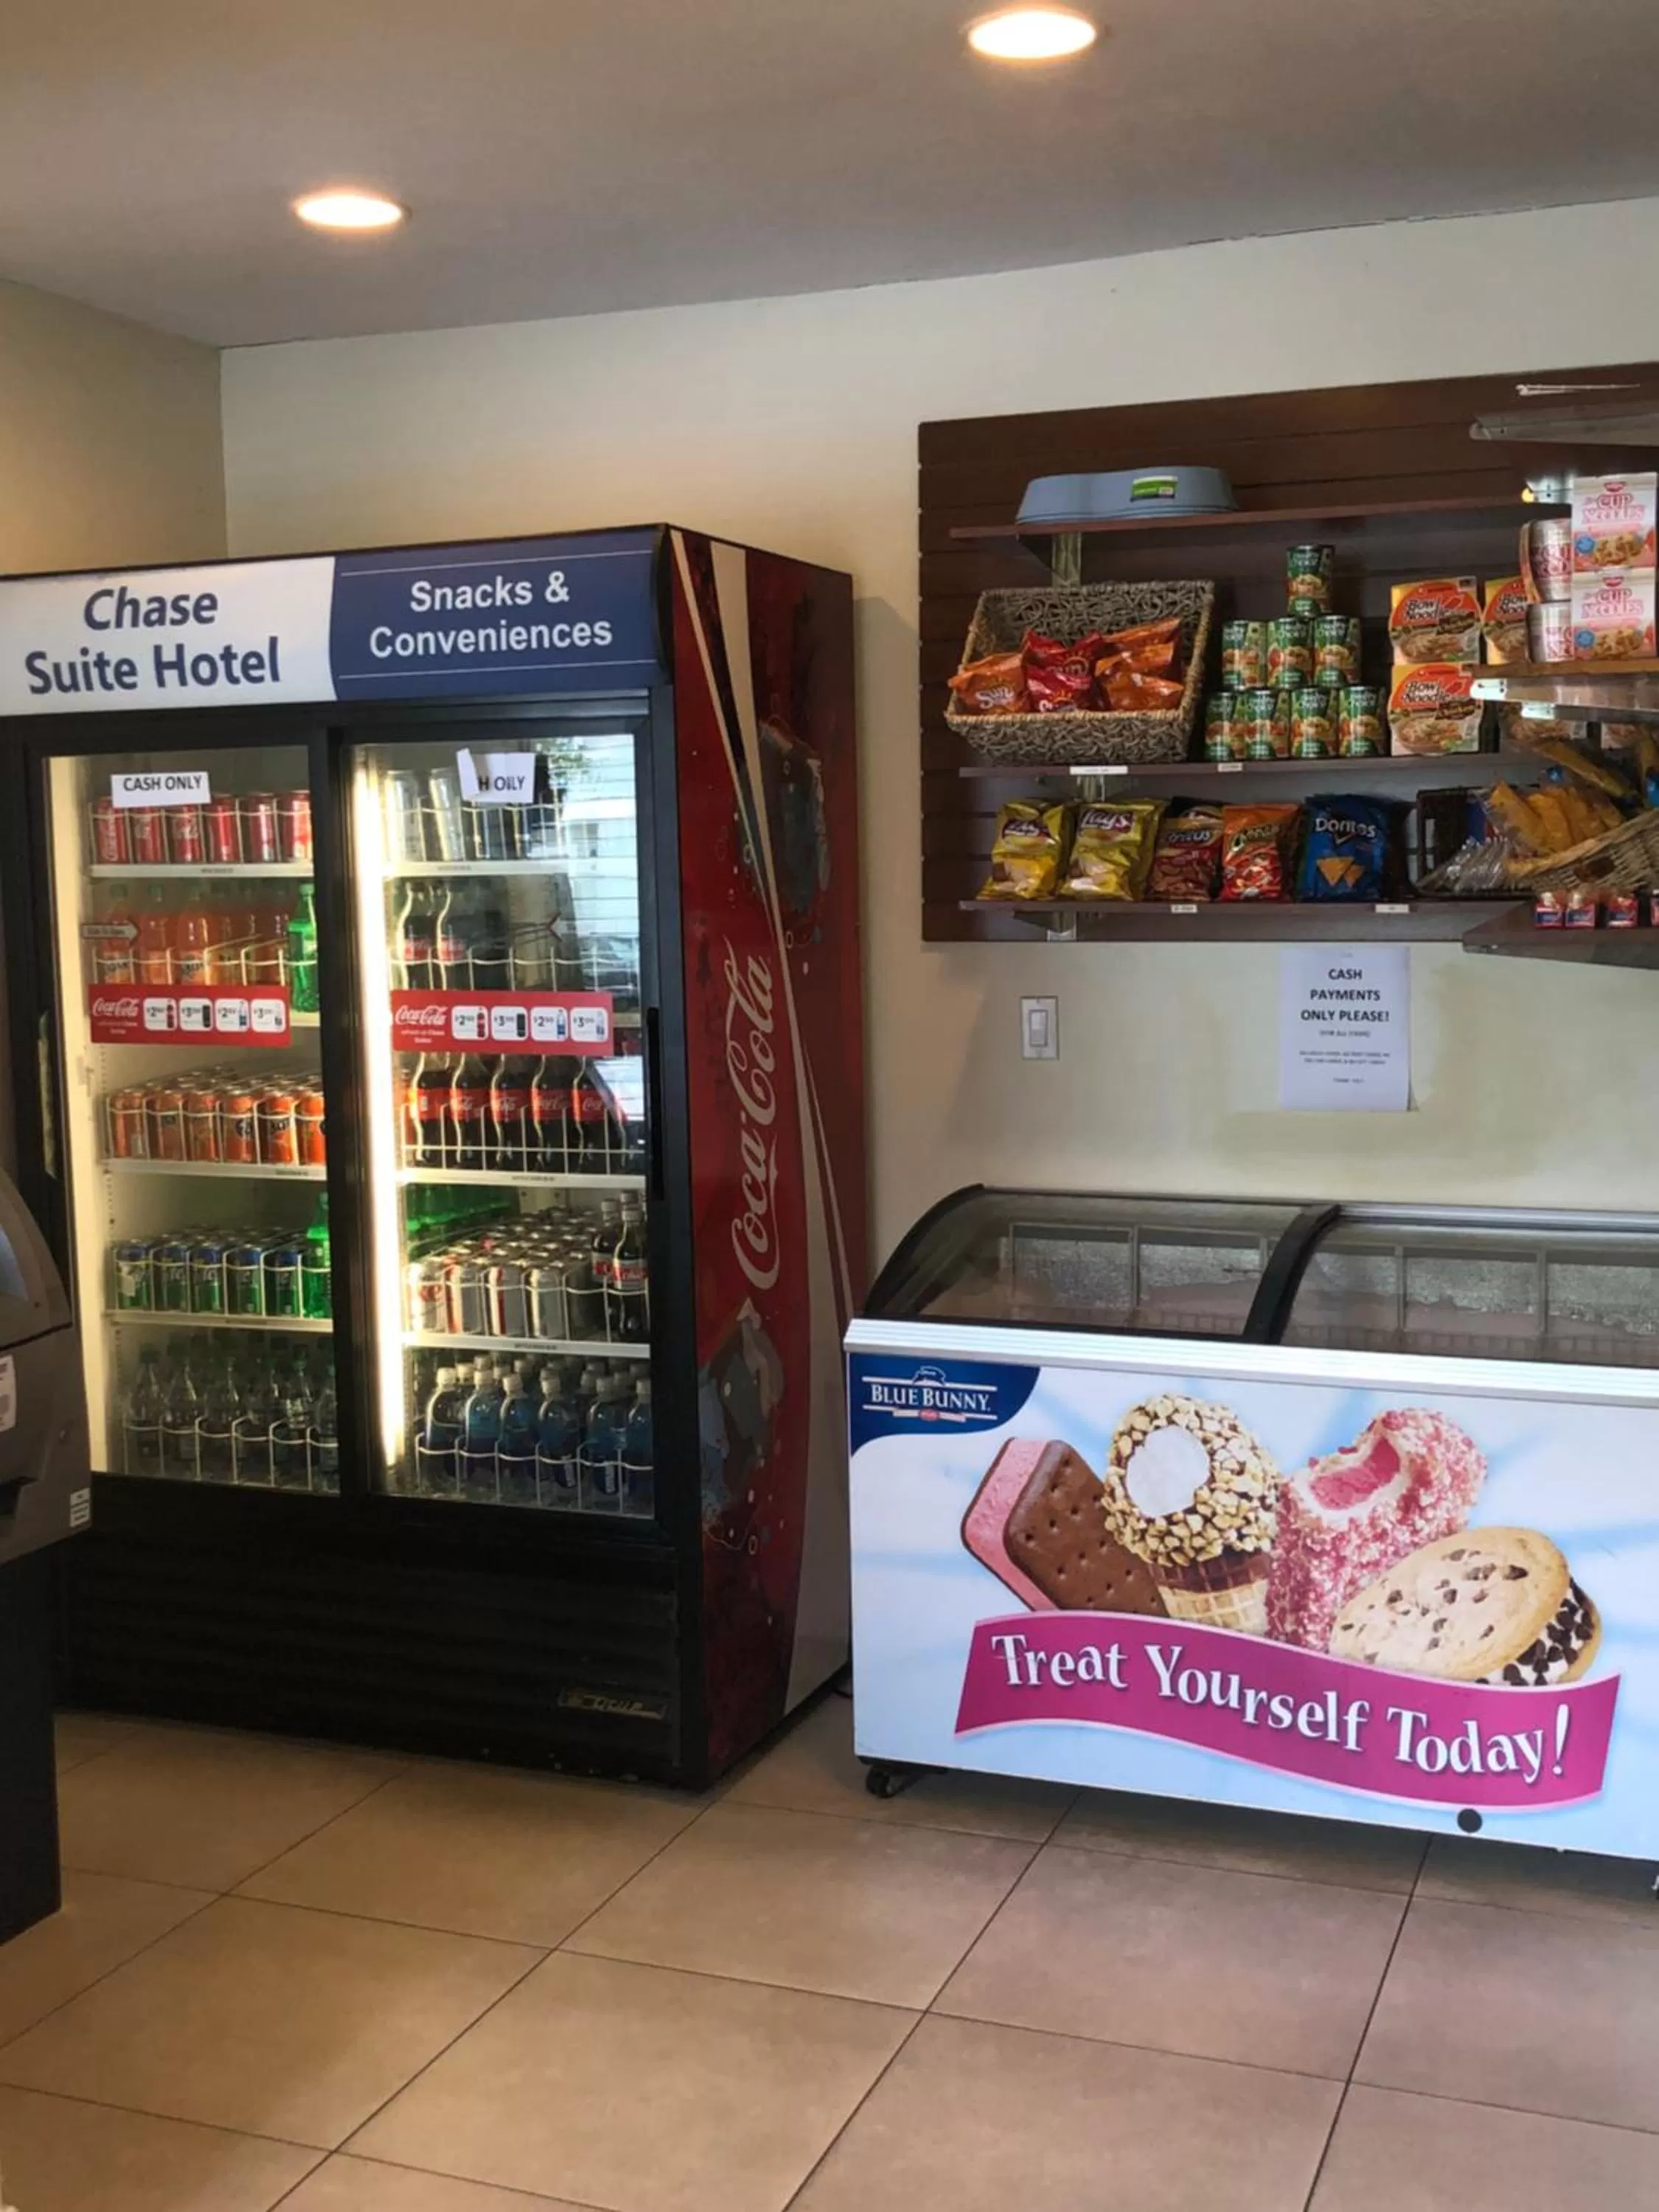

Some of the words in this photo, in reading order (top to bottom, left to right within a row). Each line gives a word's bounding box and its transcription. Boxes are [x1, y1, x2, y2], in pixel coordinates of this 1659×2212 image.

[83, 586, 219, 630] Chase
[410, 575, 533, 612] Snacks
[544, 571, 570, 604] &
[369, 617, 613, 659] Conveniences
[24, 648, 139, 695] Suite
[153, 636, 280, 690] Hotel
[123, 777, 161, 792] CASH
[165, 776, 202, 791] ONLY
[1315, 816, 1377, 839] Doritos
[1328, 968, 1363, 980] CASH
[1310, 988, 1381, 1001] PAYMENTS
[1301, 1009, 1336, 1021] ONLY
[1338, 1010, 1390, 1022] PLEASE!
[726, 933, 781, 1290] Coca-Cola
[871, 1384, 919, 1407] BLUE
[922, 1386, 990, 1411] BUNNY
[991, 1634, 1130, 1688] Treat
[1144, 1642, 1369, 1752] Yourself
[1386, 1703, 1571, 1785] Today!
